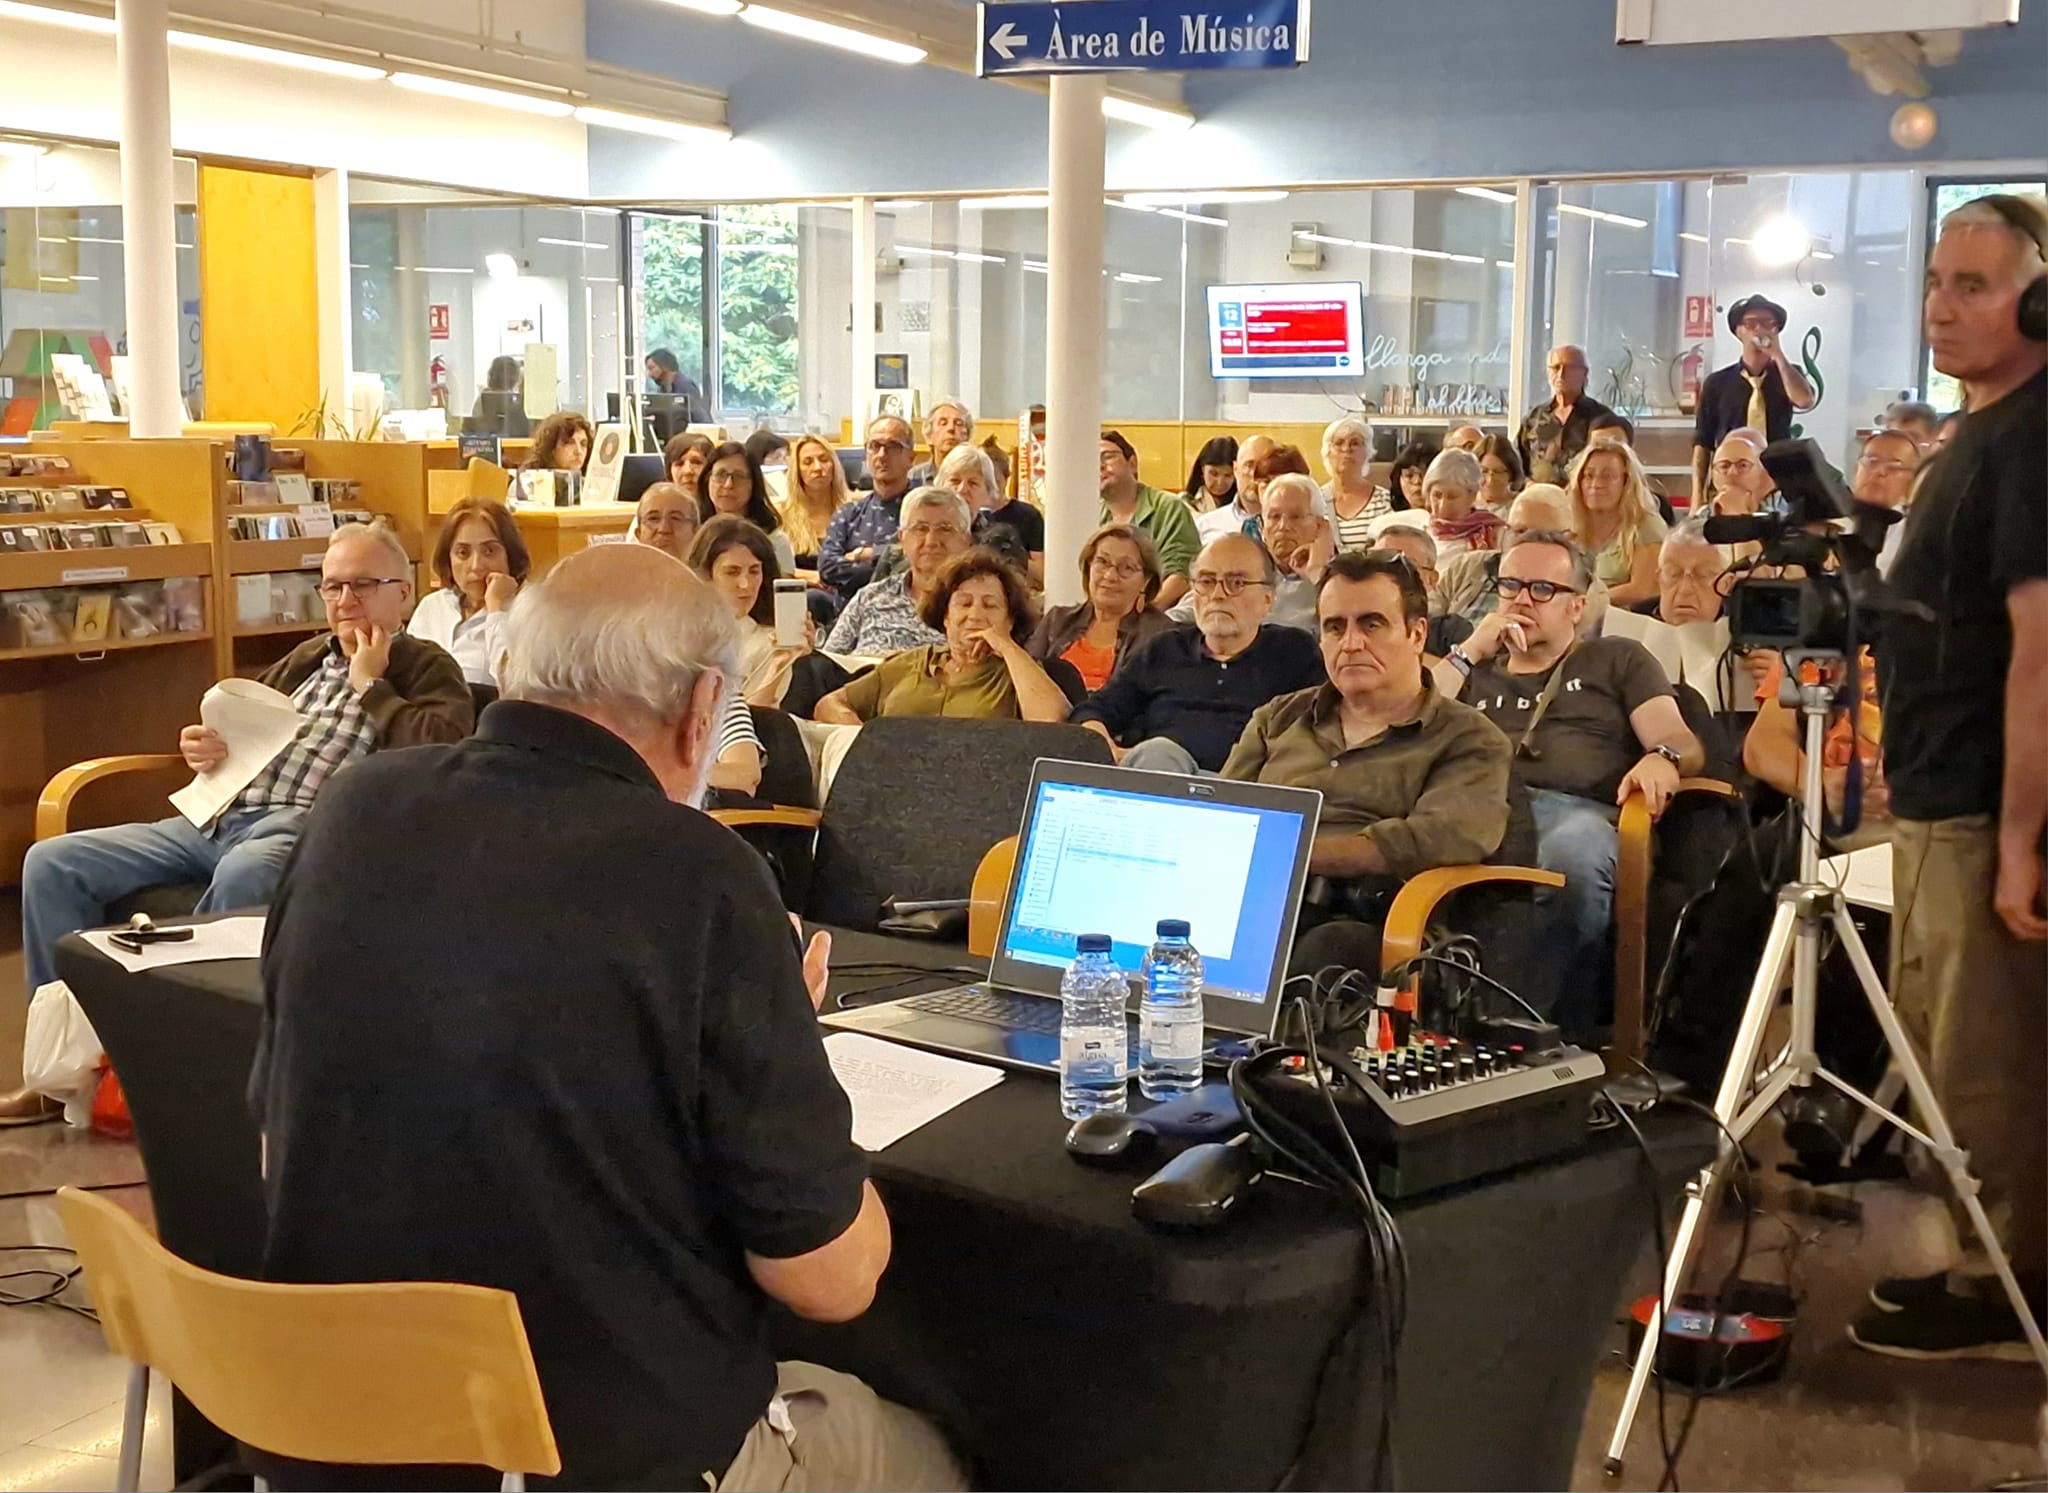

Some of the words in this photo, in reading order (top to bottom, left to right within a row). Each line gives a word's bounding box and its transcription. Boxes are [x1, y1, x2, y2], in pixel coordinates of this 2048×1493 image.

[1045, 9, 1120, 59] Àrea
[1130, 17, 1165, 56] de
[1179, 14, 1289, 54] Música
